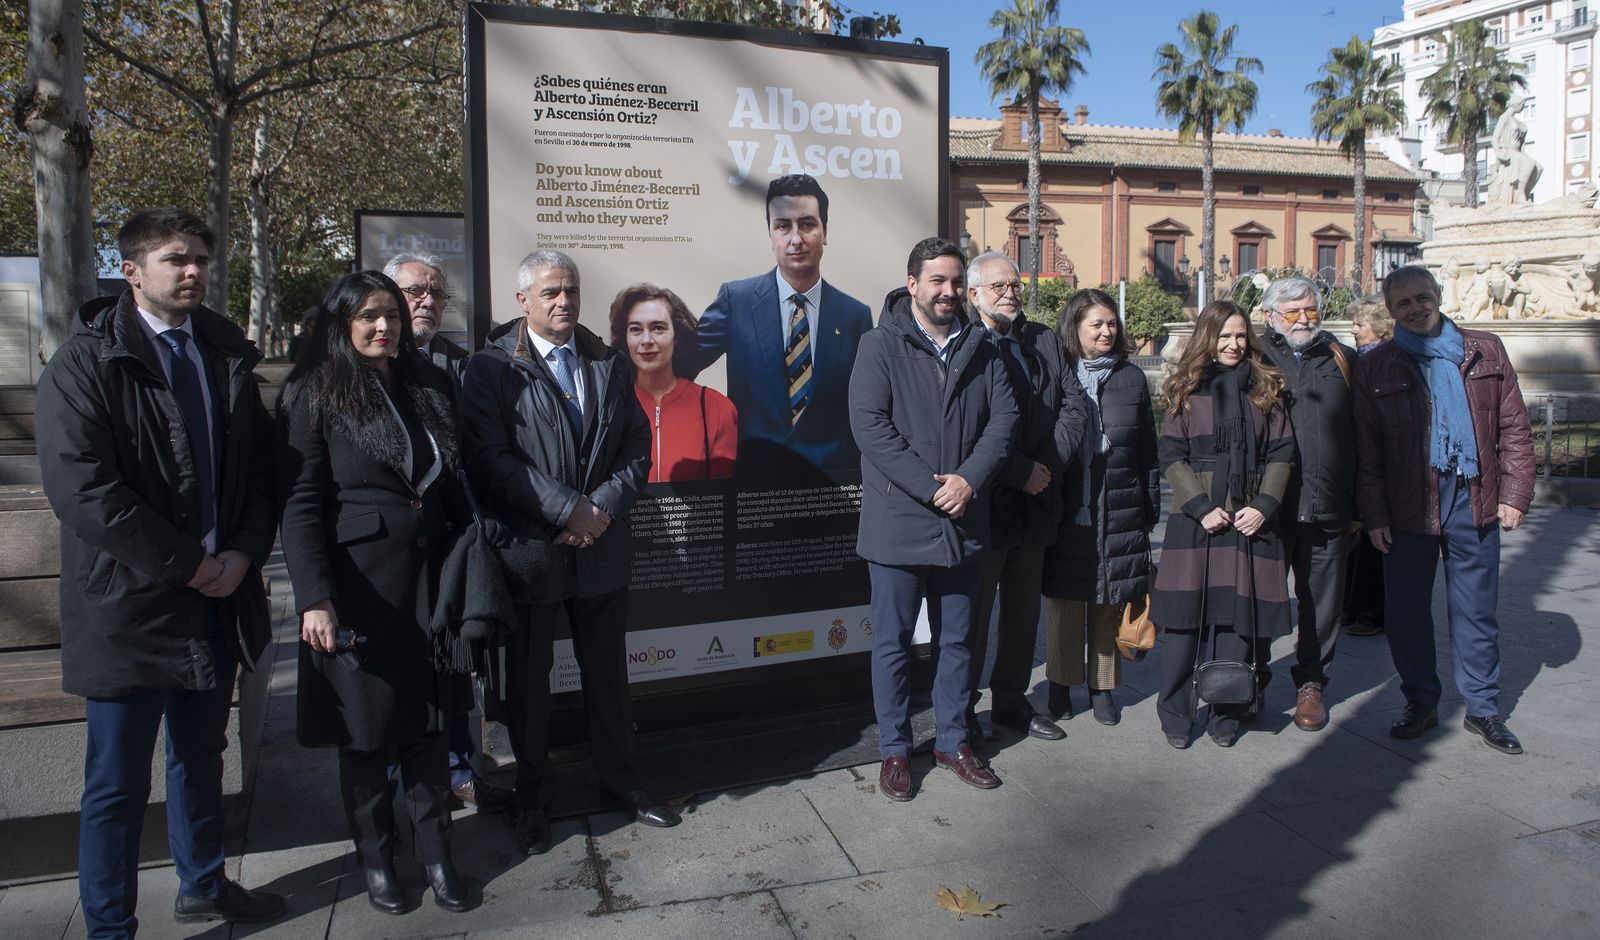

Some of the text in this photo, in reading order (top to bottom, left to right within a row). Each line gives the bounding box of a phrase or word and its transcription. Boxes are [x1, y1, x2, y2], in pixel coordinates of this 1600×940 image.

[534, 75, 667, 94] ¿Sabes quiénes eran
[534, 90, 699, 112] Alberto Jiménez-Becerril
[534, 107, 658, 124] y Ascensión Ortiz?
[728, 86, 902, 138] Alberto
[612, 133, 652, 142] organización
[728, 134, 903, 186] y Ascen
[536, 163, 662, 179] Do you know about
[536, 179, 700, 196] Alberto Jiménez-Becerril
[537, 195, 669, 210] and Ascensión Ortiz
[537, 211, 668, 227] and who they were?
